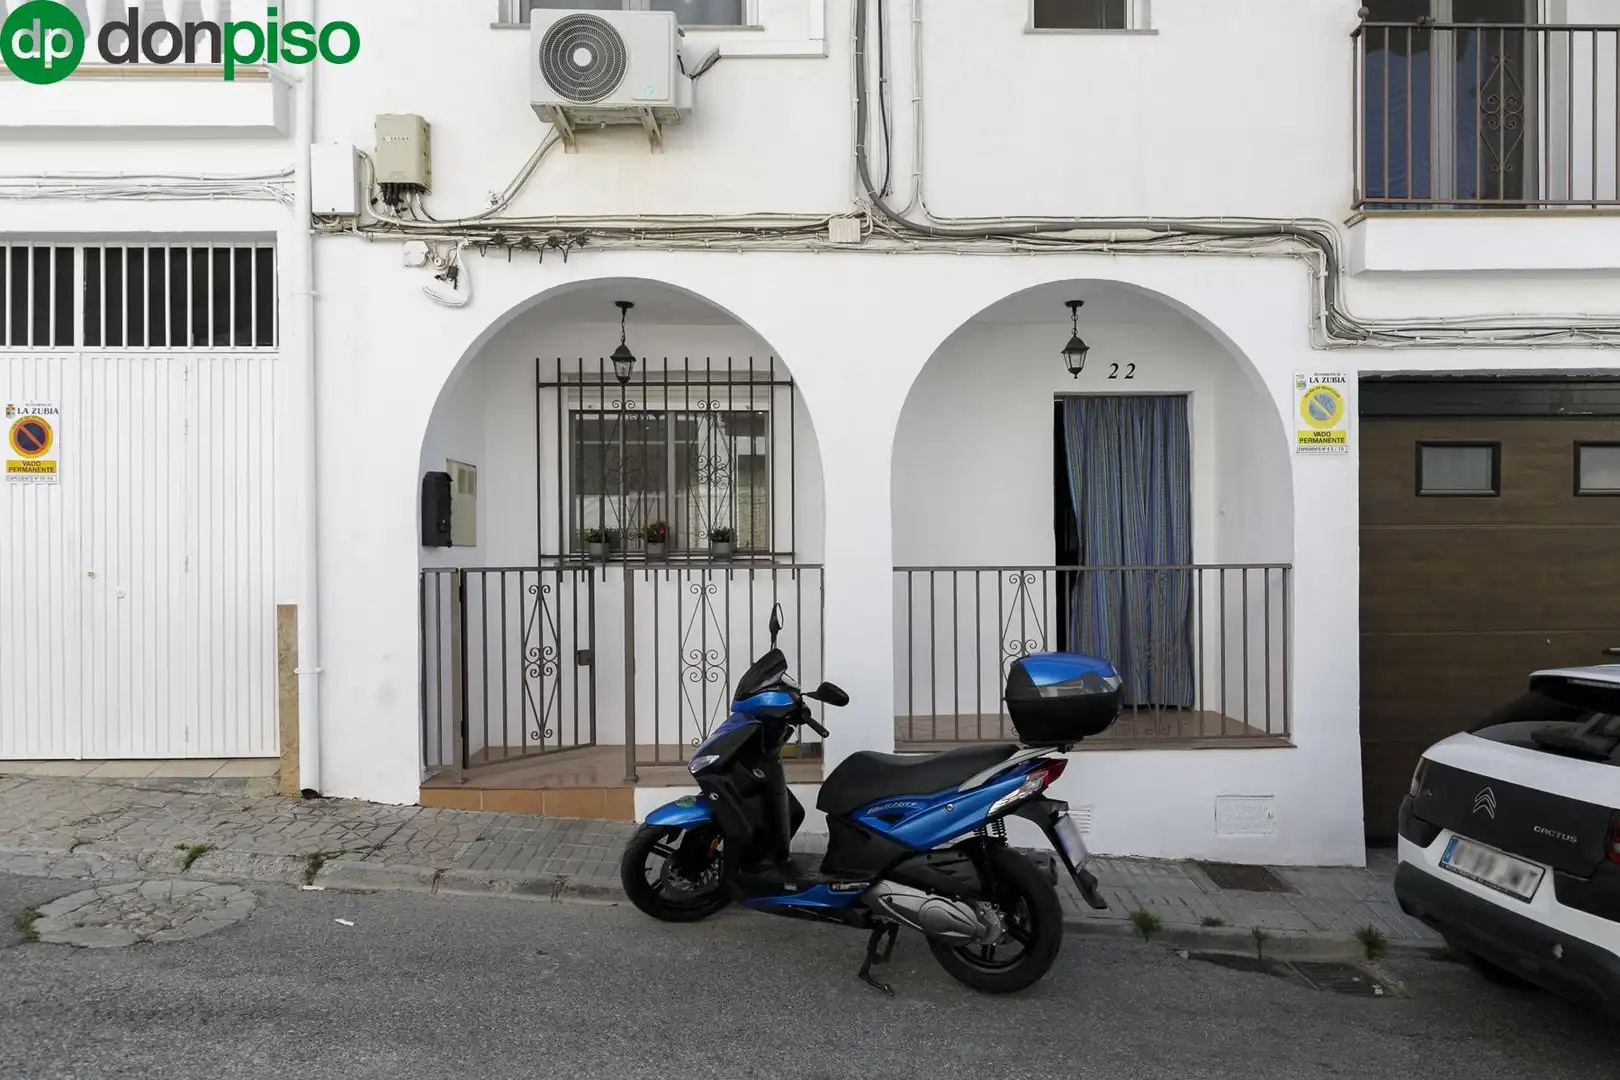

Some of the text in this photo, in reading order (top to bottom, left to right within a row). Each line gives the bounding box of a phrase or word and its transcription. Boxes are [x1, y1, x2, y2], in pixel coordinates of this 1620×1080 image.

[1107, 362, 1136, 379] 22
[17, 407, 60, 415] LA ZUBIA
[1532, 824, 1579, 844] CACTUS
